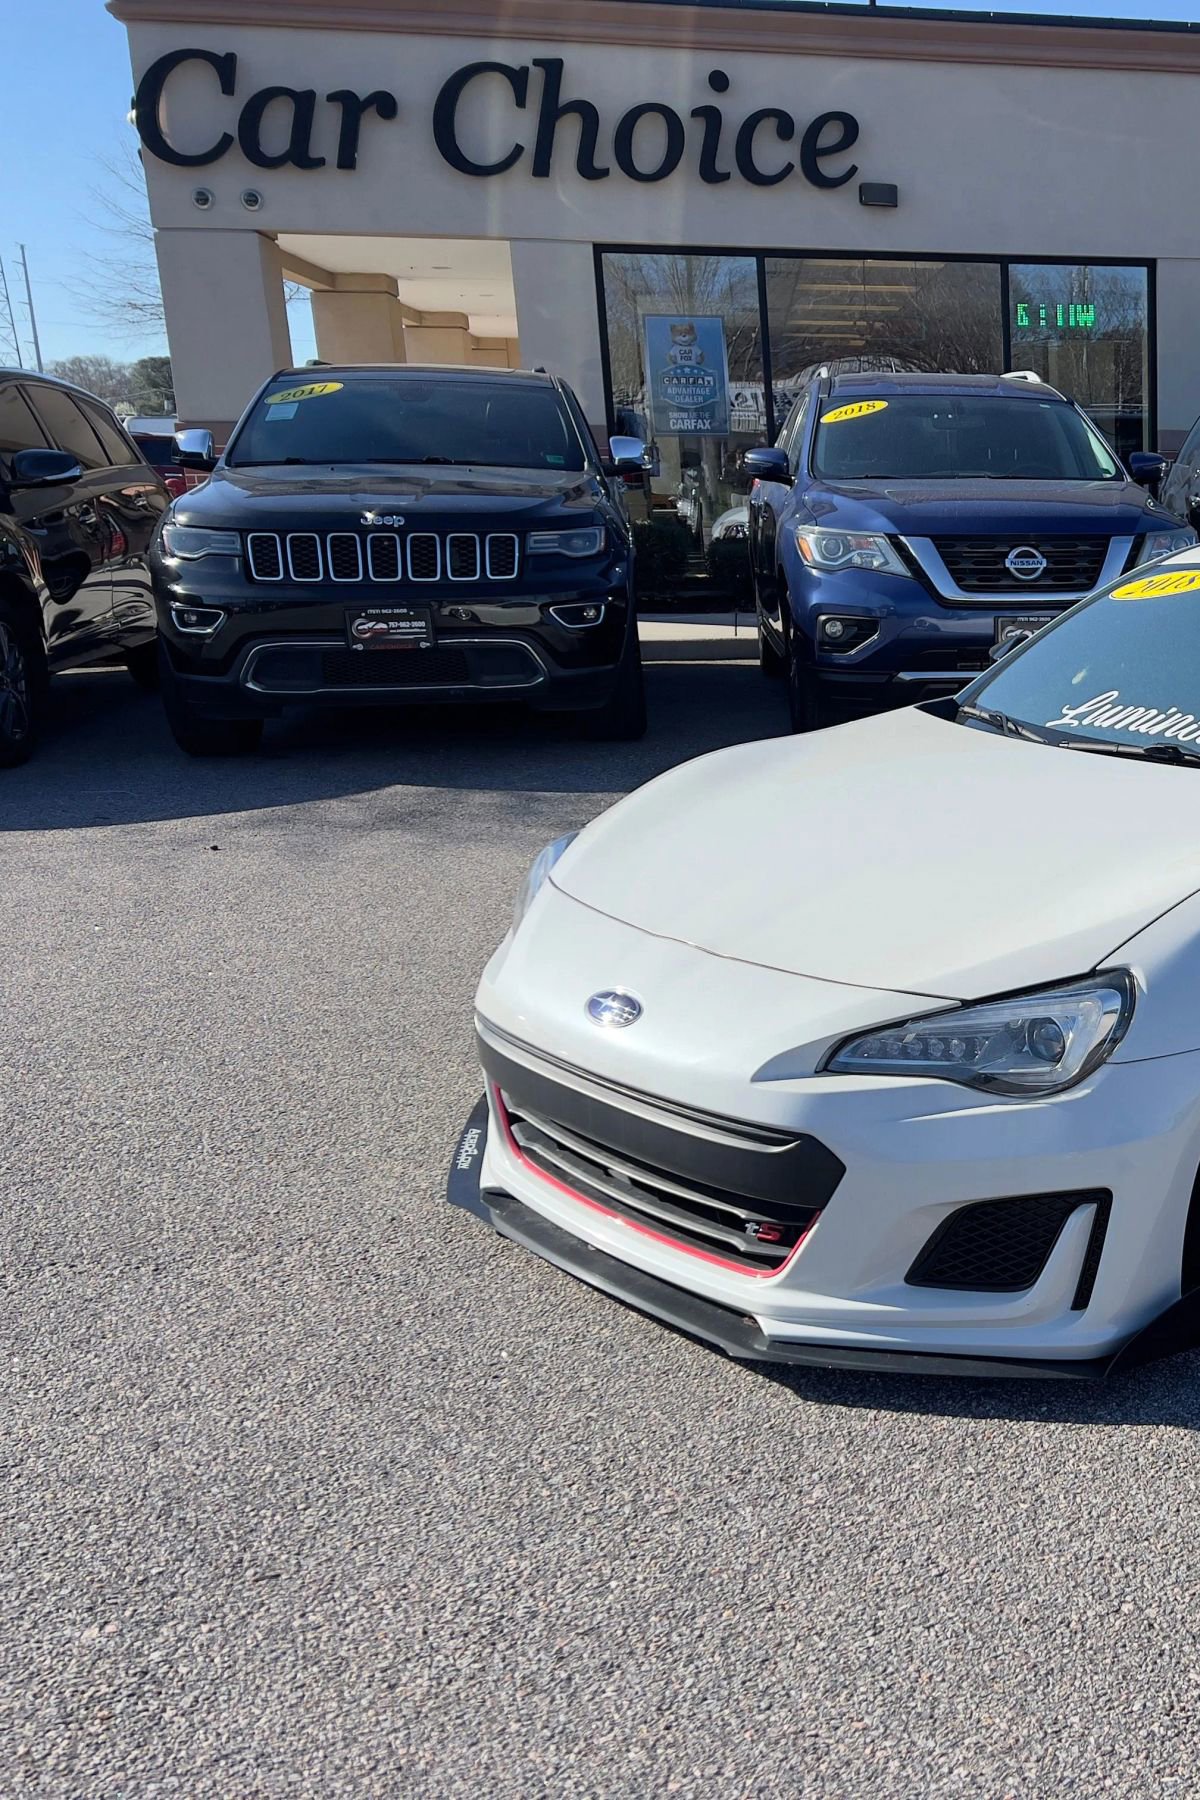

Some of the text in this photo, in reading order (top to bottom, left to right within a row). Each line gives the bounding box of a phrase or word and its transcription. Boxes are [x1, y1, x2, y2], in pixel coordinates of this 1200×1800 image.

[136, 48, 860, 188] Car Choice
[279, 384, 328, 402] 2017
[667, 387, 711, 395] ADVANTAGE
[675, 395, 704, 403] DEALER
[833, 402, 877, 420] 2018
[669, 419, 712, 430] CARFAX
[360, 511, 405, 527] Jeep
